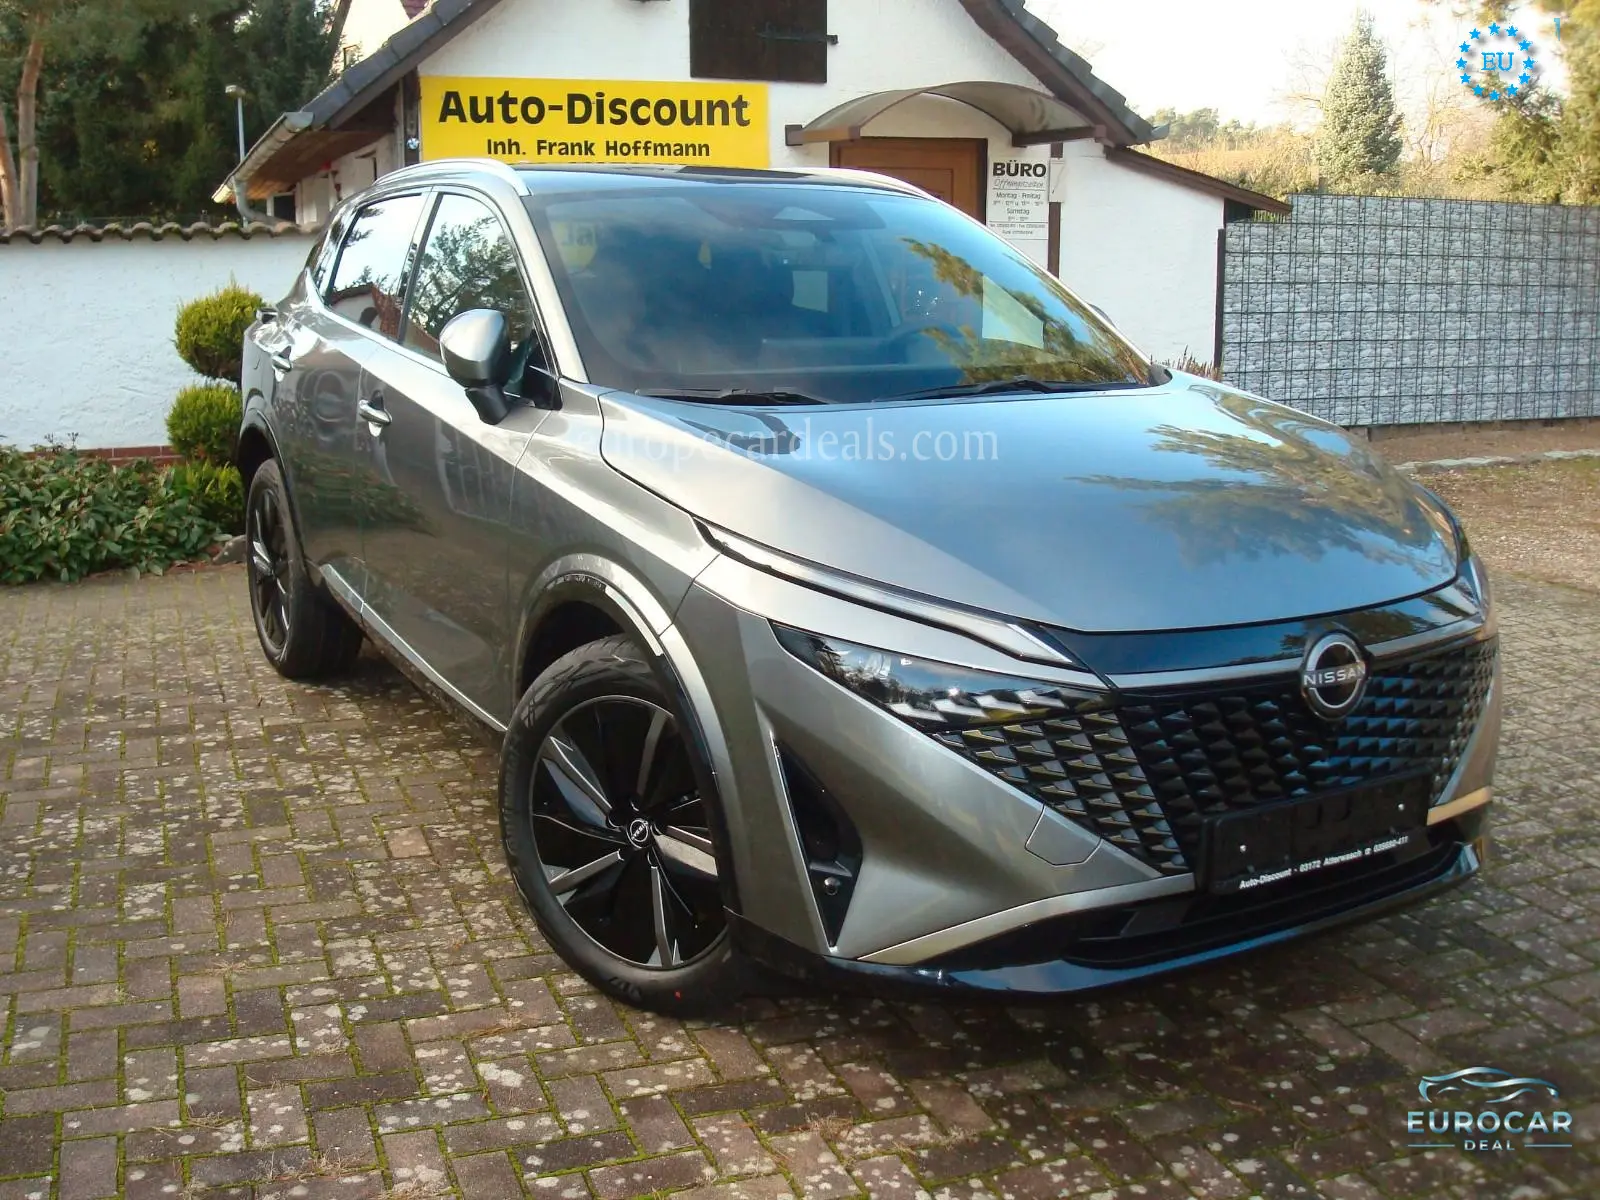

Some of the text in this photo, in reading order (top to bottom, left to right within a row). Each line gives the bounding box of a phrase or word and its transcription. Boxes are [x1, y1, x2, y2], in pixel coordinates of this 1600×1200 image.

[438, 90, 751, 127] Auto-Discount
[487, 138, 710, 157] Inh. Frank Hoffmann
[992, 159, 1047, 178] BÜRO
